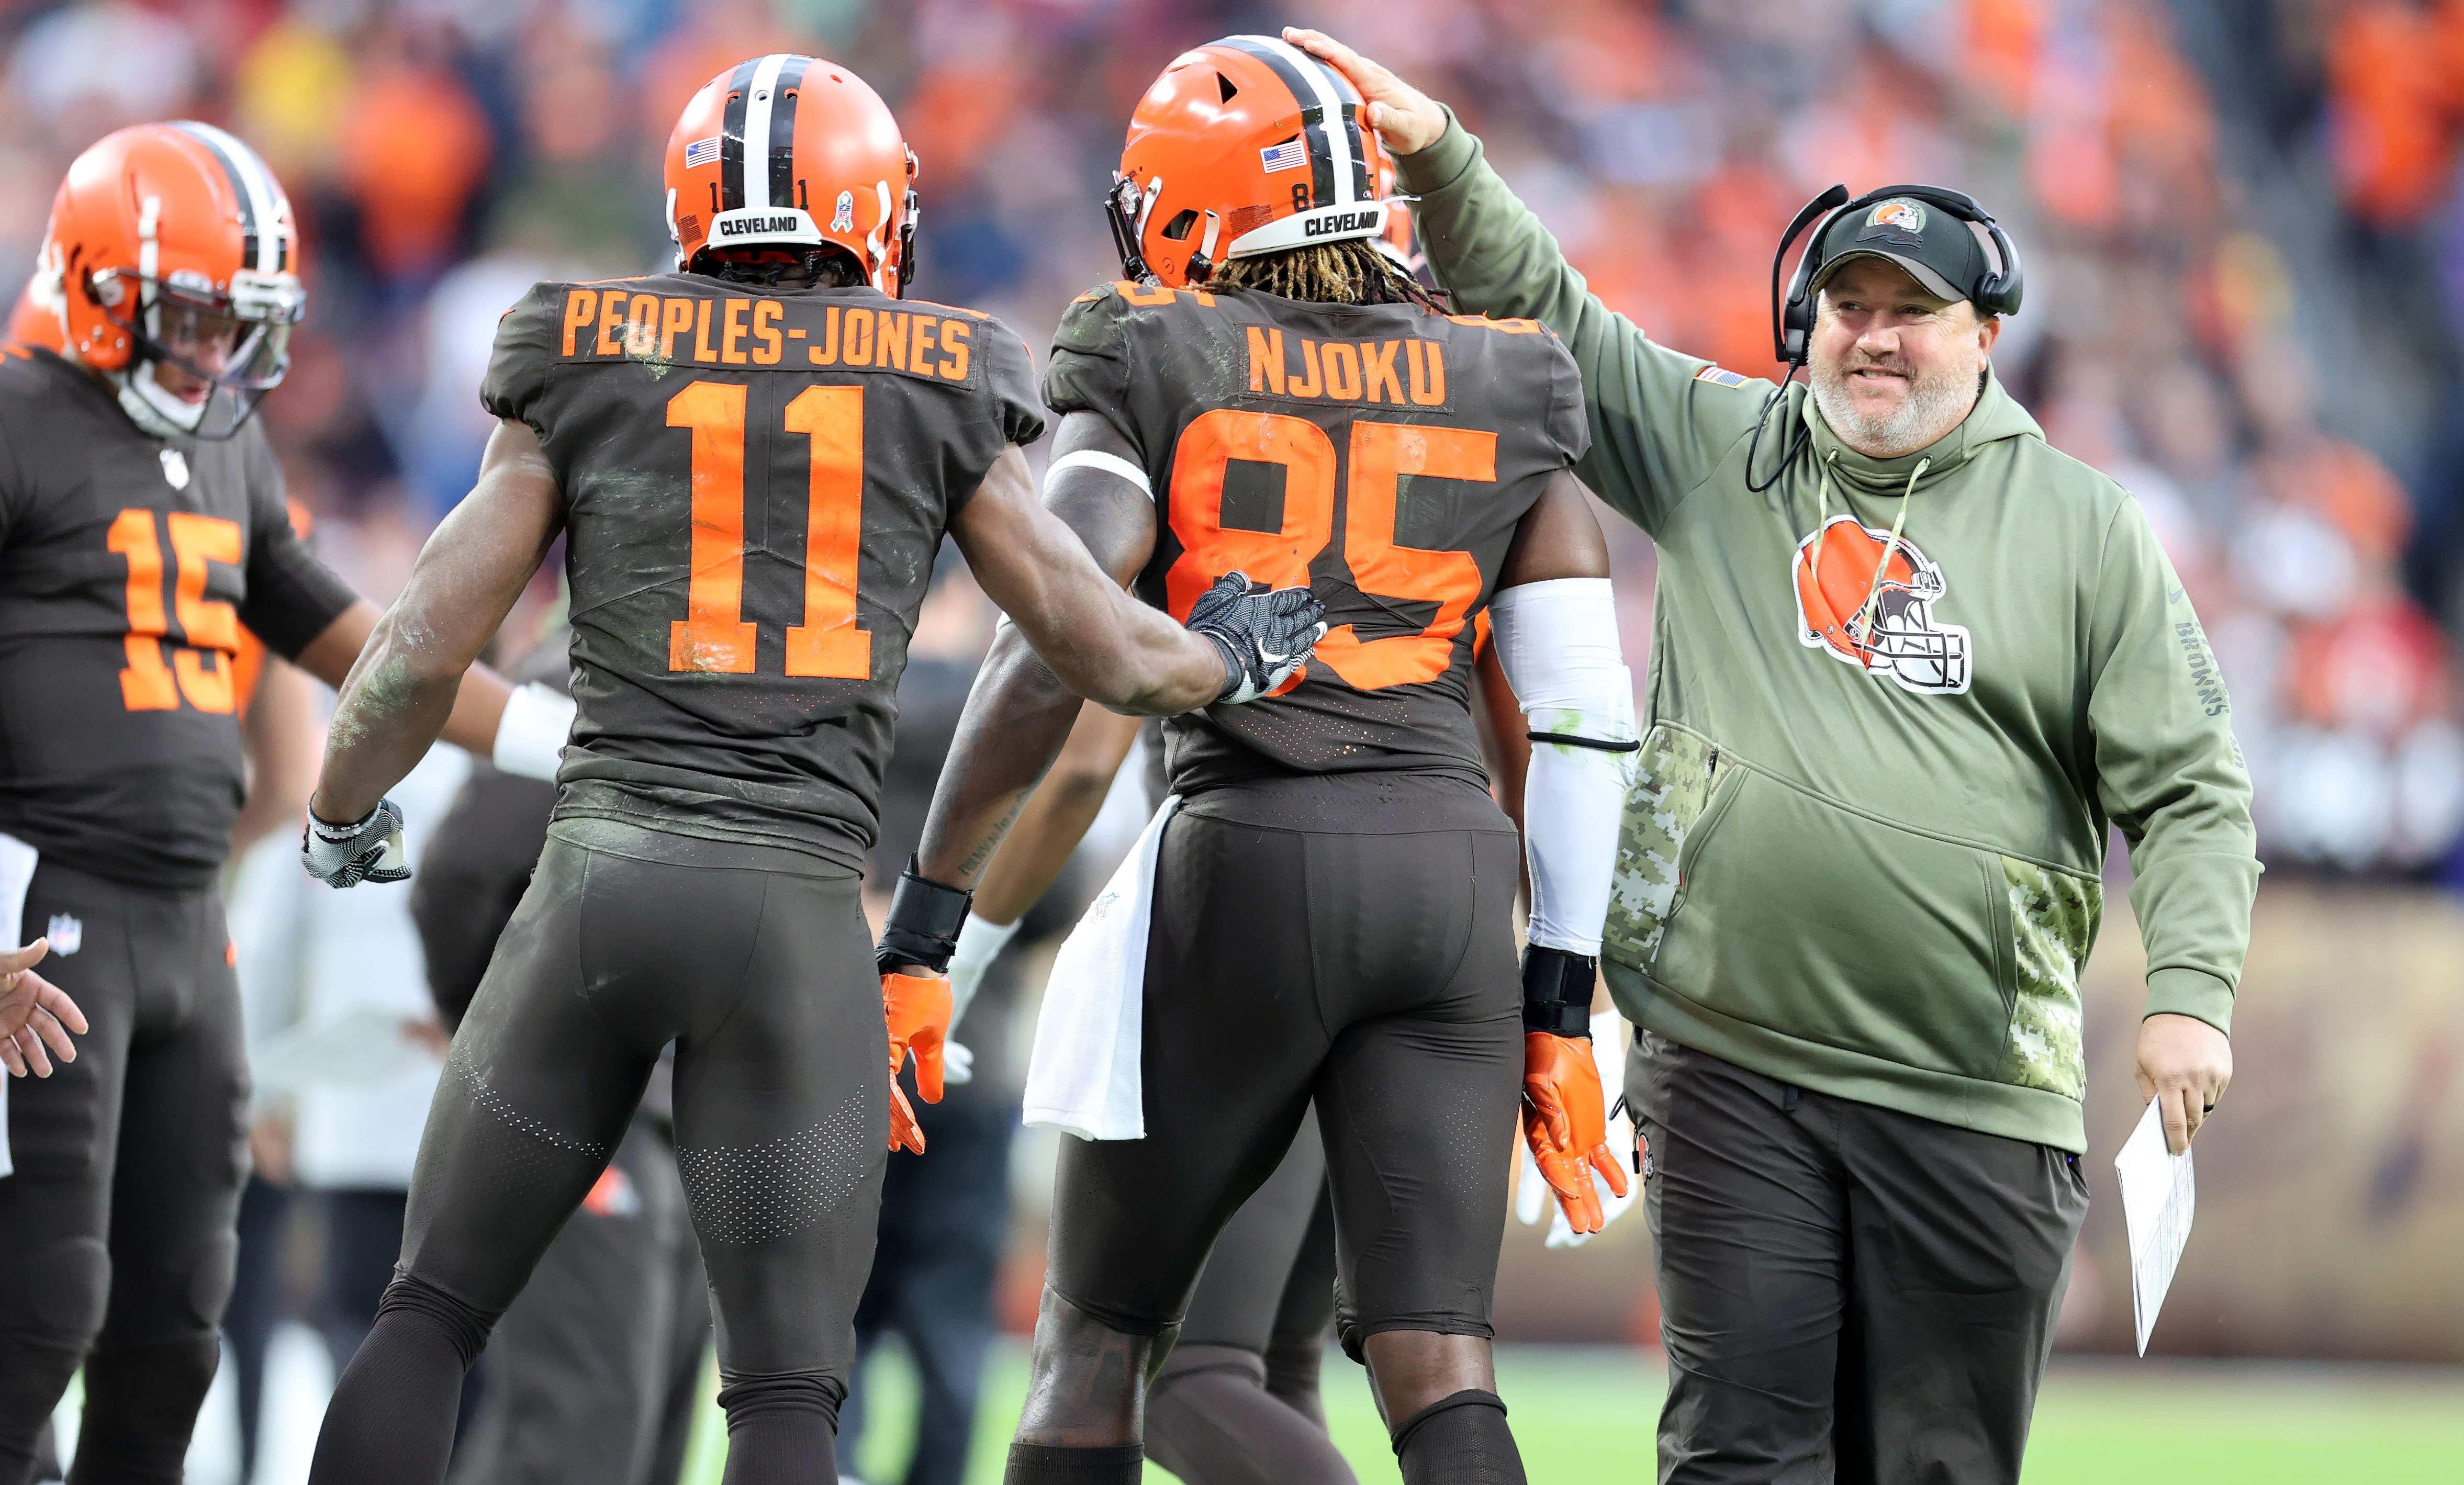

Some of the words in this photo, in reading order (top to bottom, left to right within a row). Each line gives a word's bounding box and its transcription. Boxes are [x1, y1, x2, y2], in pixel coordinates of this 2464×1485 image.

[720, 216, 797, 235] CLEVELAND
[839, 211, 849, 220] NFL
[1305, 211, 1379, 237] CLEVELAND
[562, 289, 970, 381] PEOPLES-JONES
[1246, 327, 1446, 406] NJOKU
[666, 380, 872, 680] 11
[1165, 408, 1498, 697] 85
[107, 508, 242, 715] 15
[2175, 622, 2230, 716] BROWNS
